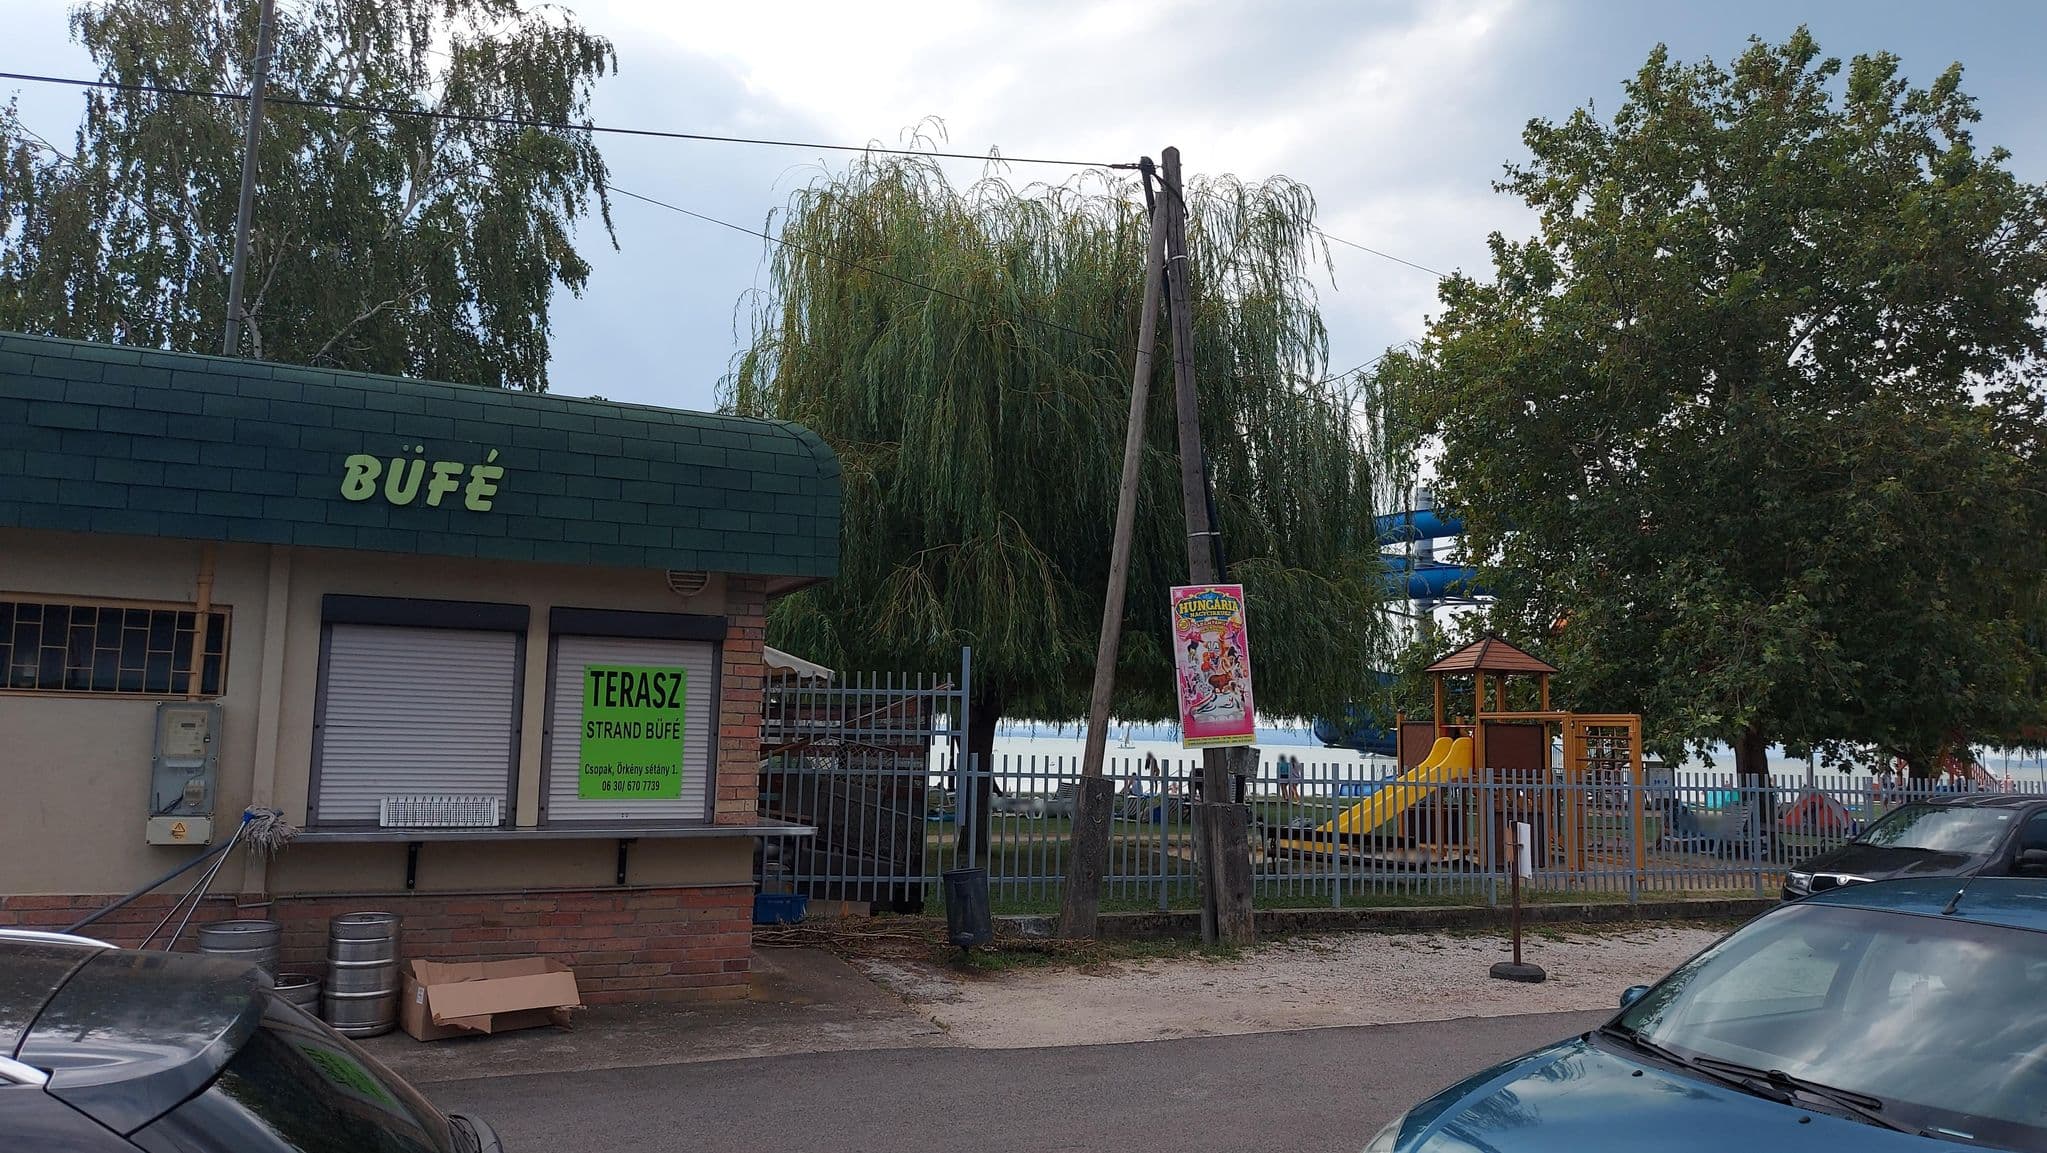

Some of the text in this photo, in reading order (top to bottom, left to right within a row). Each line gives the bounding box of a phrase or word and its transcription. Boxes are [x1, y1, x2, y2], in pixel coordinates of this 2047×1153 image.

[340, 444, 504, 512] BÜFÉ
[590, 670, 682, 709] TERASZ
[586, 717, 680, 740] STRAND BÜFÉ
[584, 761, 678, 777] Csopak, Örkény sétány 1.
[602, 780, 660, 793] 06 30/ 670 7739
